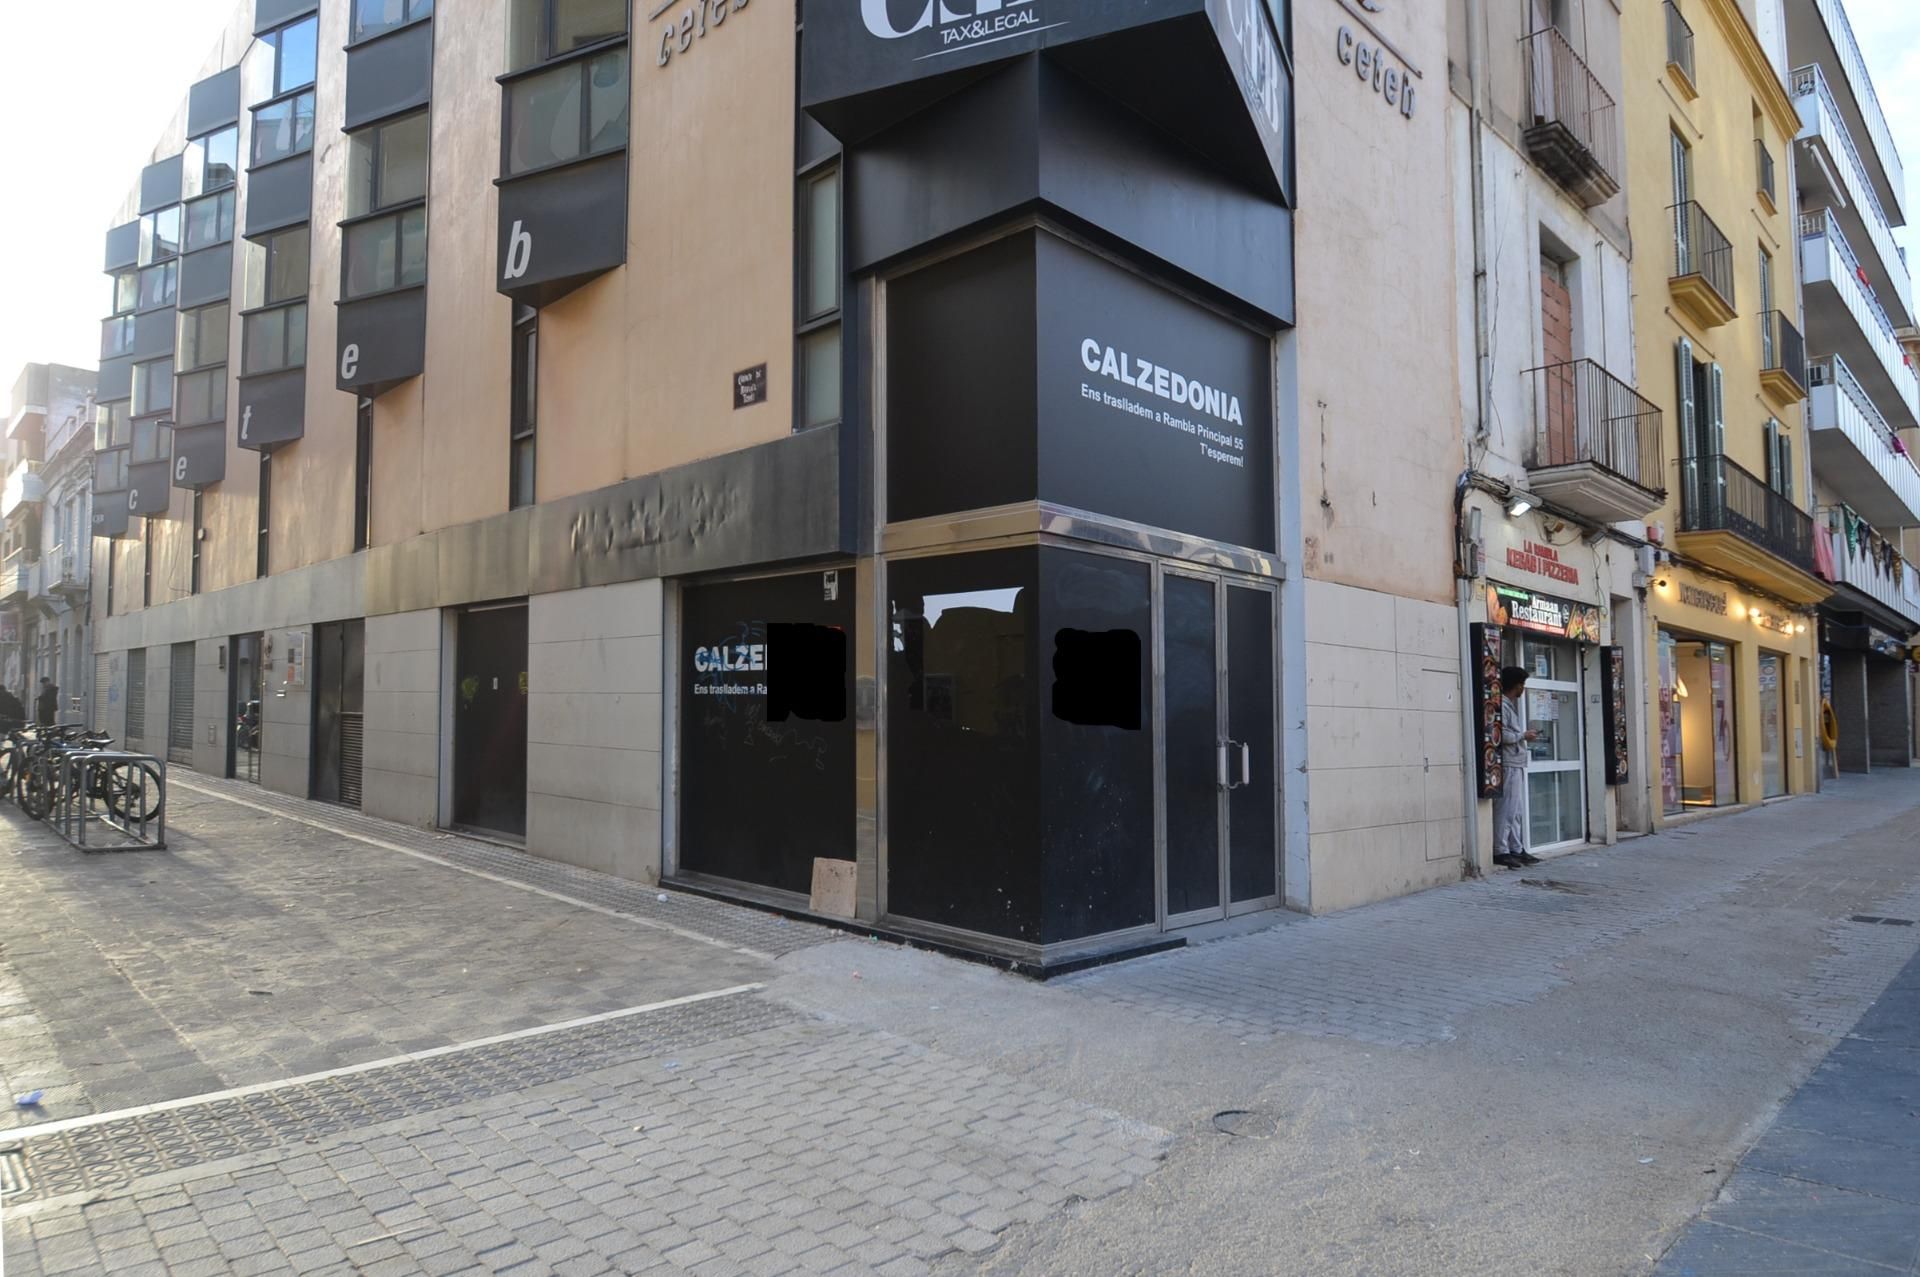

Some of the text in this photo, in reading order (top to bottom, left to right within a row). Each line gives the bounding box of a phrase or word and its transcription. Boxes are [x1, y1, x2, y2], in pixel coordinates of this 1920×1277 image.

[940, 8, 1039, 45] TAX&LEGAL
[504, 219, 532, 280] b
[341, 343, 360, 380] e
[1081, 338, 1243, 426] CALZEDONIA
[1081, 383, 1244, 451] Ens traslladem a Rambla Principal 55
[175, 455, 188, 481] e
[1200, 442, 1244, 468] T'esperem!
[1523, 539, 1533, 555] LA
[1511, 600, 1562, 628] Restaurant
[694, 683, 708, 695] Ens
